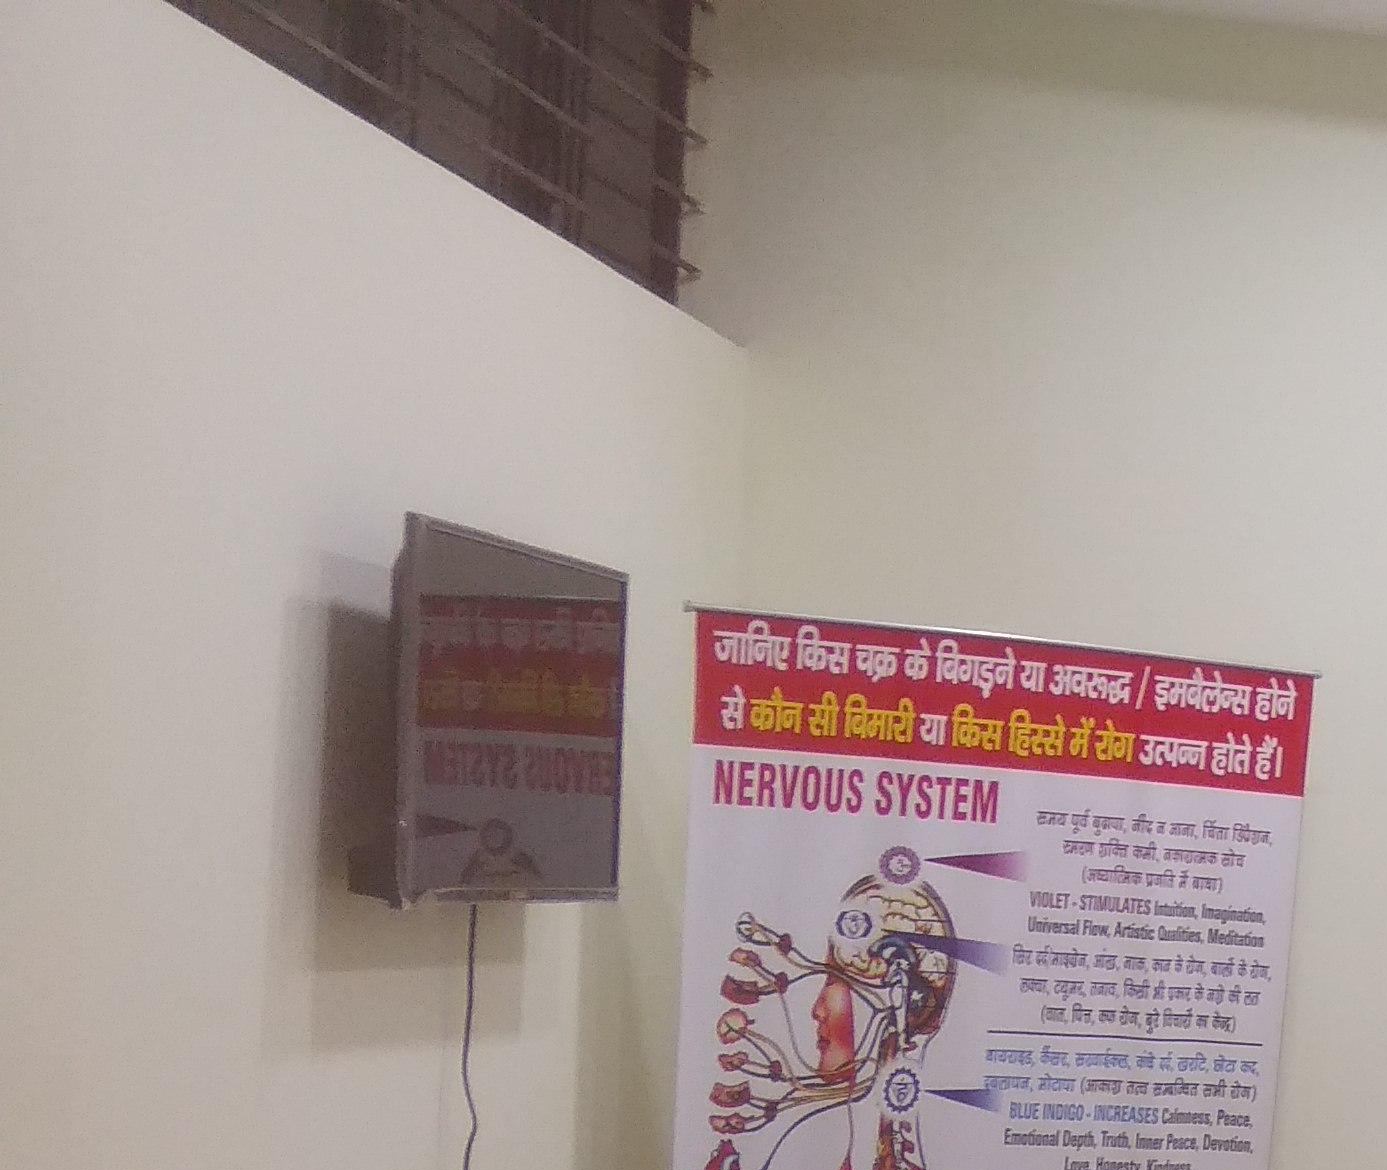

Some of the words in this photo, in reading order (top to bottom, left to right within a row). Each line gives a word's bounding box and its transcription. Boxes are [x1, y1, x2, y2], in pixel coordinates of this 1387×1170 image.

[713, 620, 792, 671] जानिए
[796, 625, 852, 674] किस
[855, 645, 900, 682] चक्र
[904, 637, 931, 681] के
[936, 639, 1016, 699] बिगड़ने
[1019, 661, 1048, 693] या
[1135, 665, 1151, 709] /
[1255, 678, 1297, 720] होने
[720, 684, 746, 730] से
[750, 686, 804, 734] कौन
[808, 691, 839, 737] सी
[843, 693, 916, 743] बिमारी
[919, 713, 948, 745] या
[952, 703, 1005, 751] किस
[1008, 708, 1067, 758] हिस्से
[1070, 716, 1097, 758] में
[1096, 719, 1136, 763] रोग
[1138, 735, 1208, 770] उत्पन्न
[1211, 731, 1251, 775] होते
[713, 759, 864, 814] NERVOUS
[874, 770, 999, 824] SYSTEM
[1009, 1102, 1040, 1120] BLUE
[1043, 1103, 1085, 1121] INDIGO
[1094, 1104, 1158, 1124] INCREASES
[1216, 1109, 1253, 1129] Peace,
